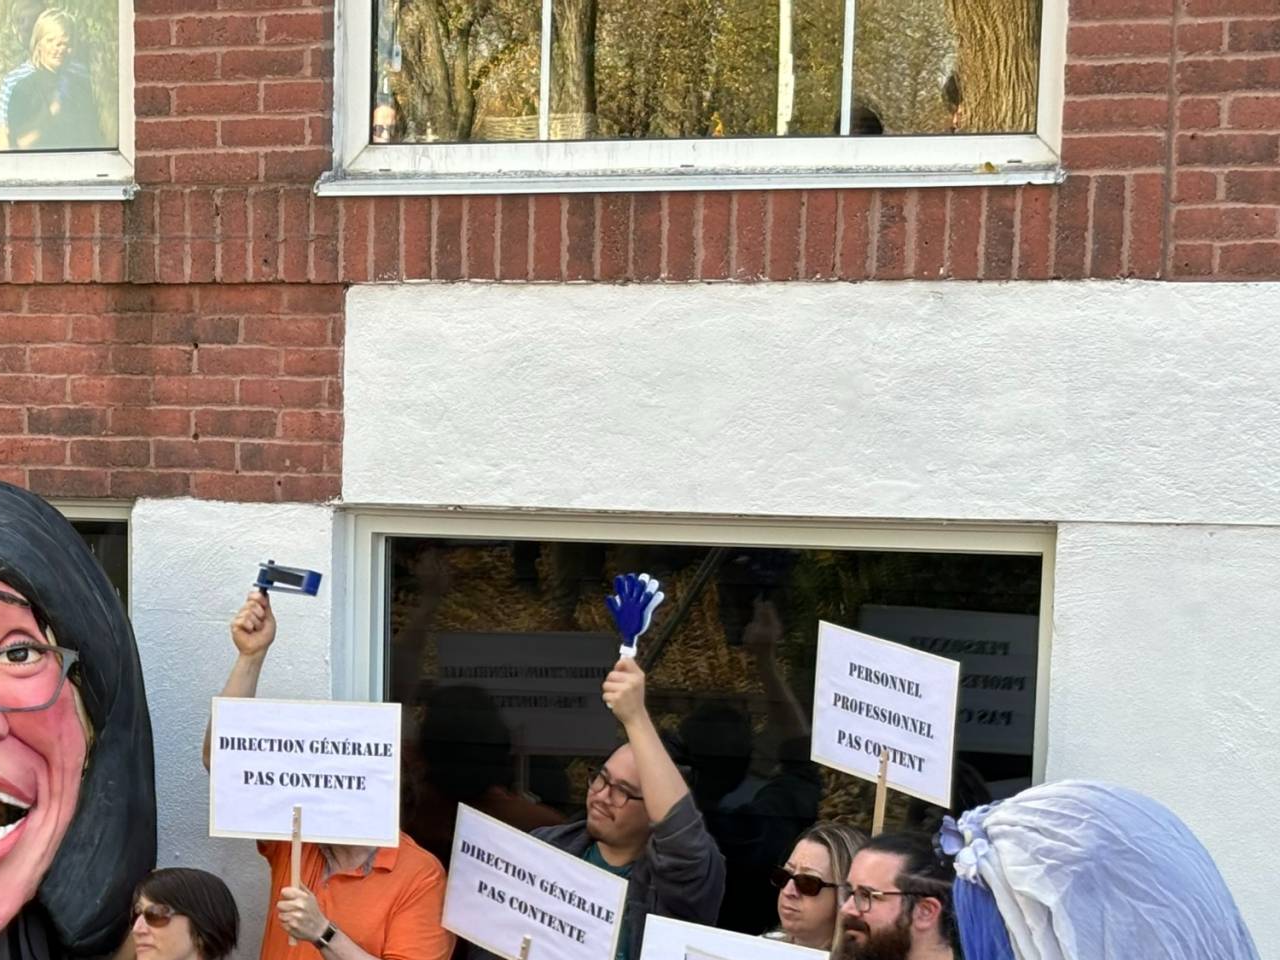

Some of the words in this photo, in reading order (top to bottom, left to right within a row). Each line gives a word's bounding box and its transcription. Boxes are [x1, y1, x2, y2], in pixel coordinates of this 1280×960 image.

[848, 661, 922, 699] PERSONNEL
[832, 692, 934, 739] PROFESSIONNEL
[219, 736, 305, 754] DIRECTION
[309, 737, 393, 757] GÉNÉRALE
[837, 729, 862, 752] PAS
[243, 770, 275, 786] PAS
[279, 772, 366, 791] CONTENTE
[459, 840, 538, 887] DIRECTION
[539, 877, 615, 925] GÉNÉRALE
[477, 880, 507, 905] PAS
[509, 896, 587, 944] CONTENTE
